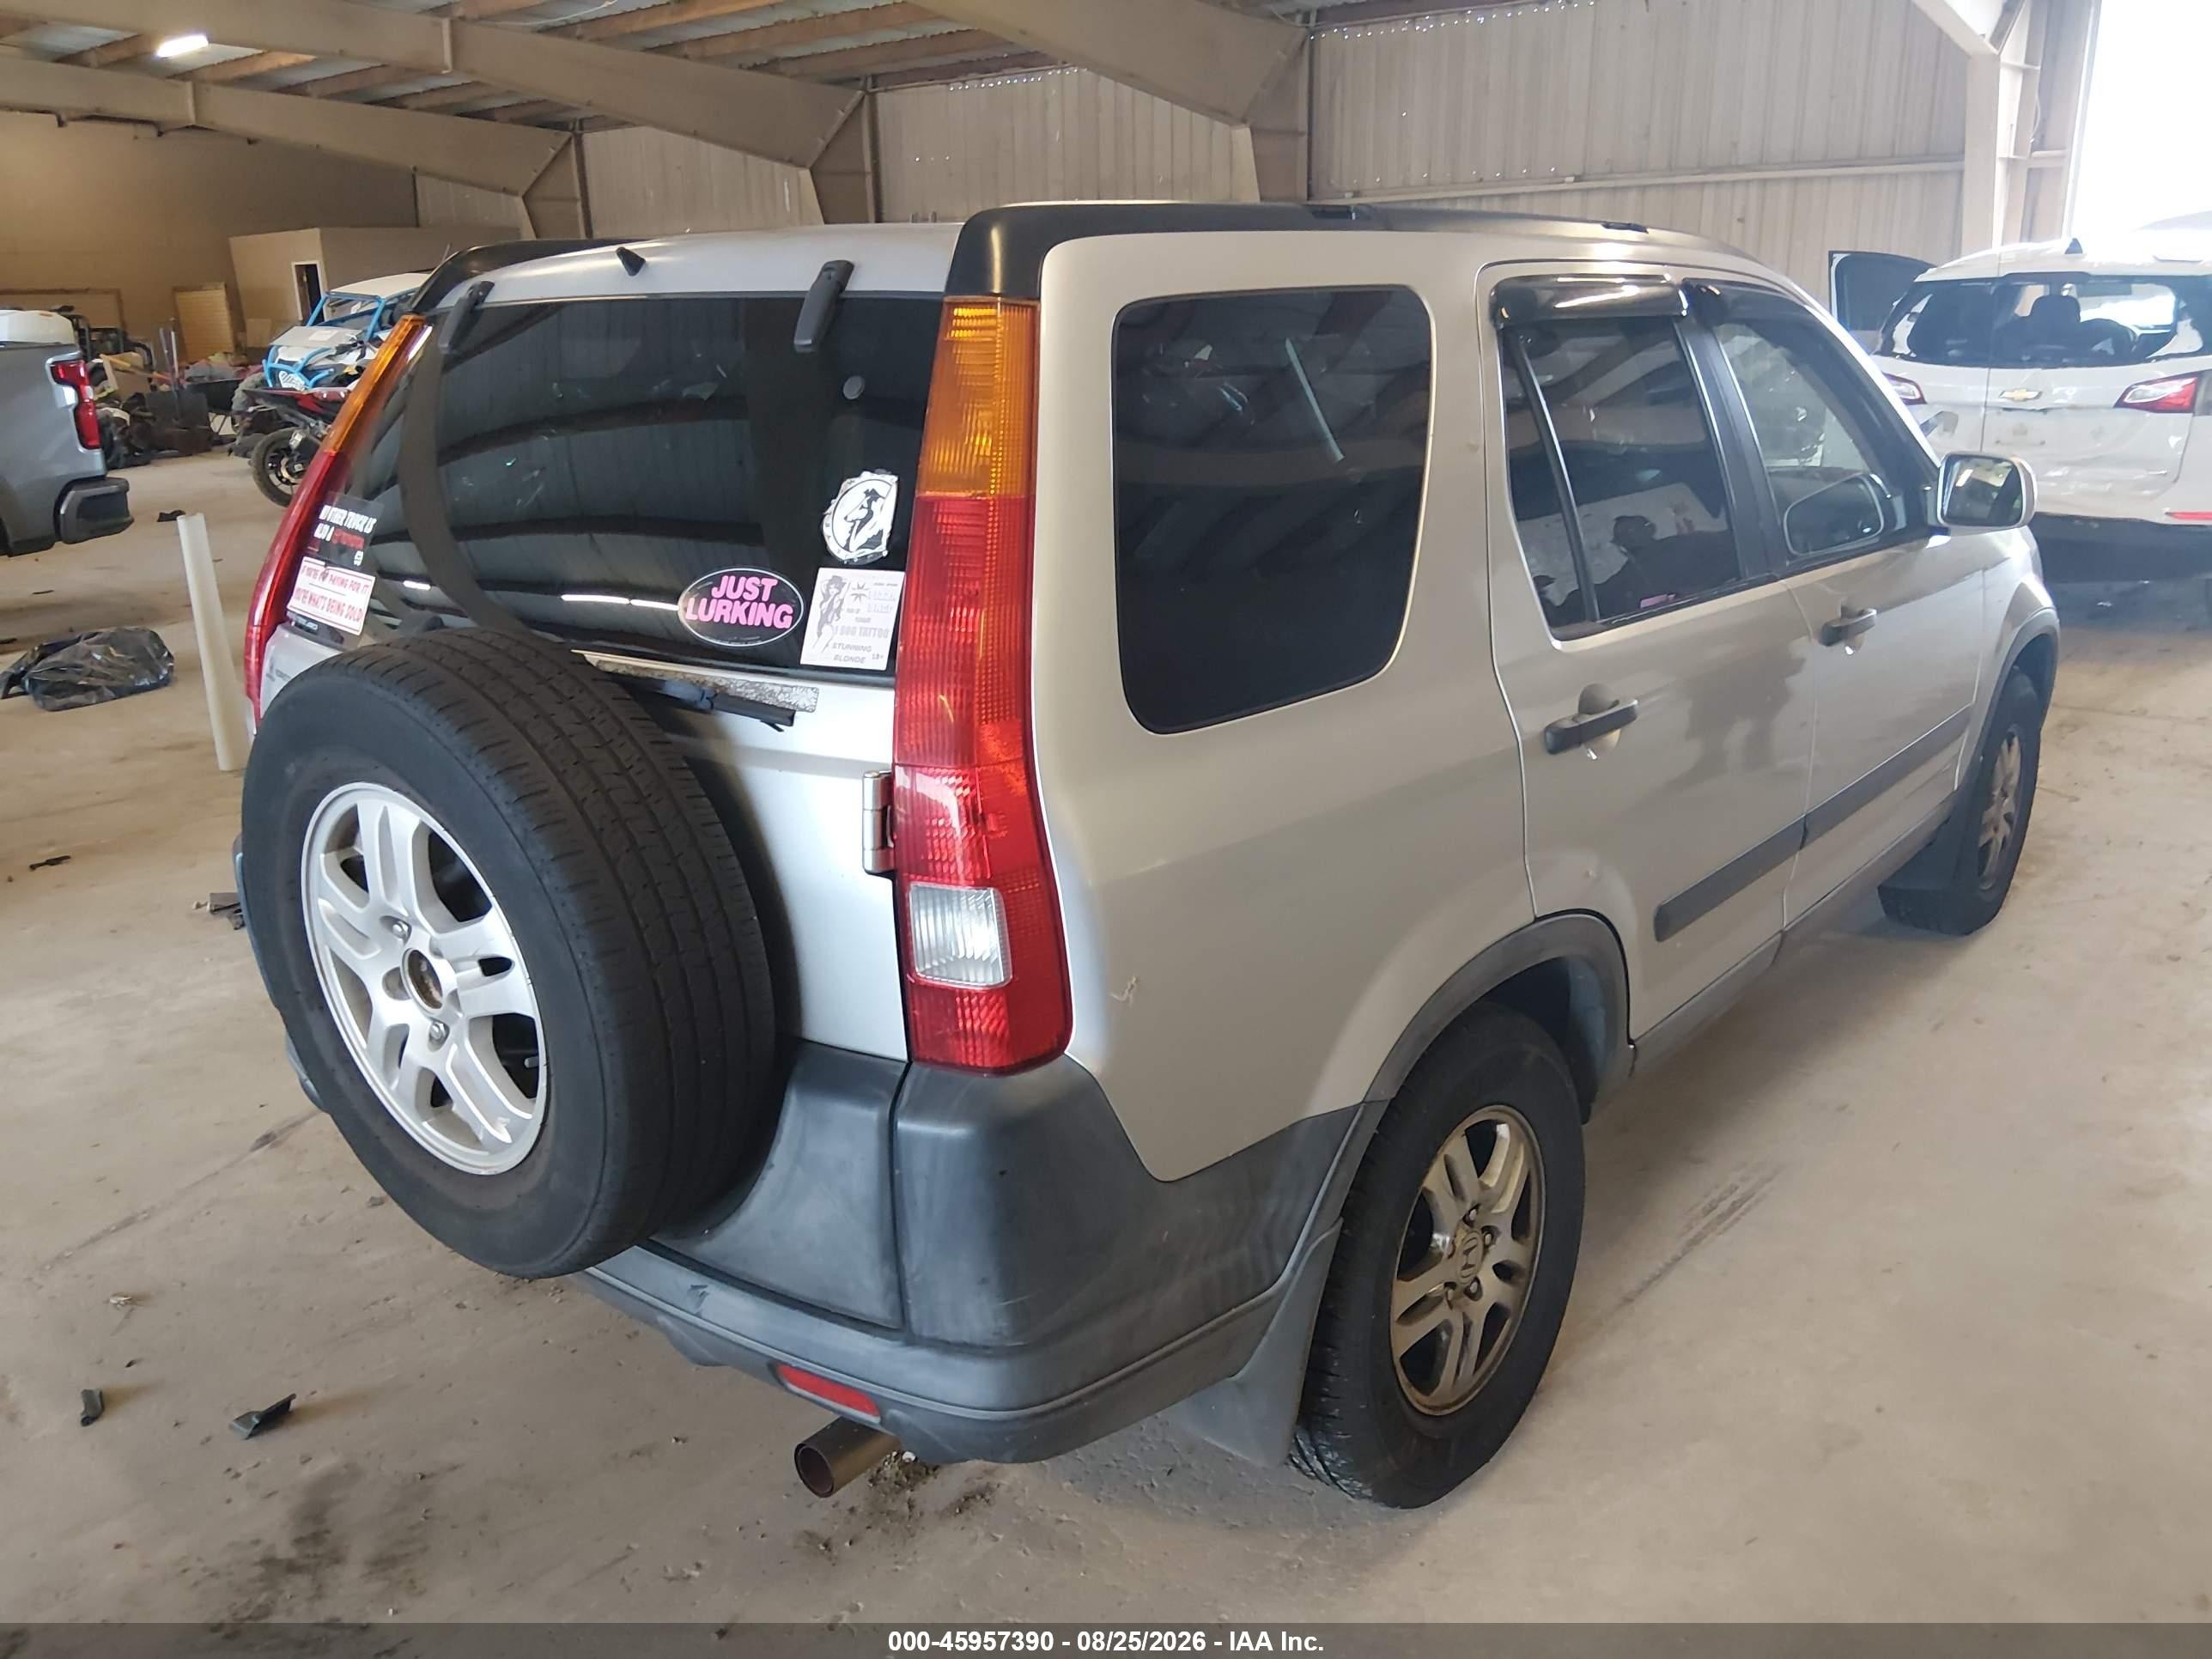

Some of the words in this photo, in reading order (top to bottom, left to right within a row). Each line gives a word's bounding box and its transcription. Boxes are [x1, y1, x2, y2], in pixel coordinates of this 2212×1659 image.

[349, 580, 361, 592] FOR
[711, 575, 778, 602] JUST
[344, 605, 365, 623] SOLD
[685, 598, 793, 629] LURKING
[832, 641, 872, 653] STUNNING
[833, 653, 866, 665] BLONDE
